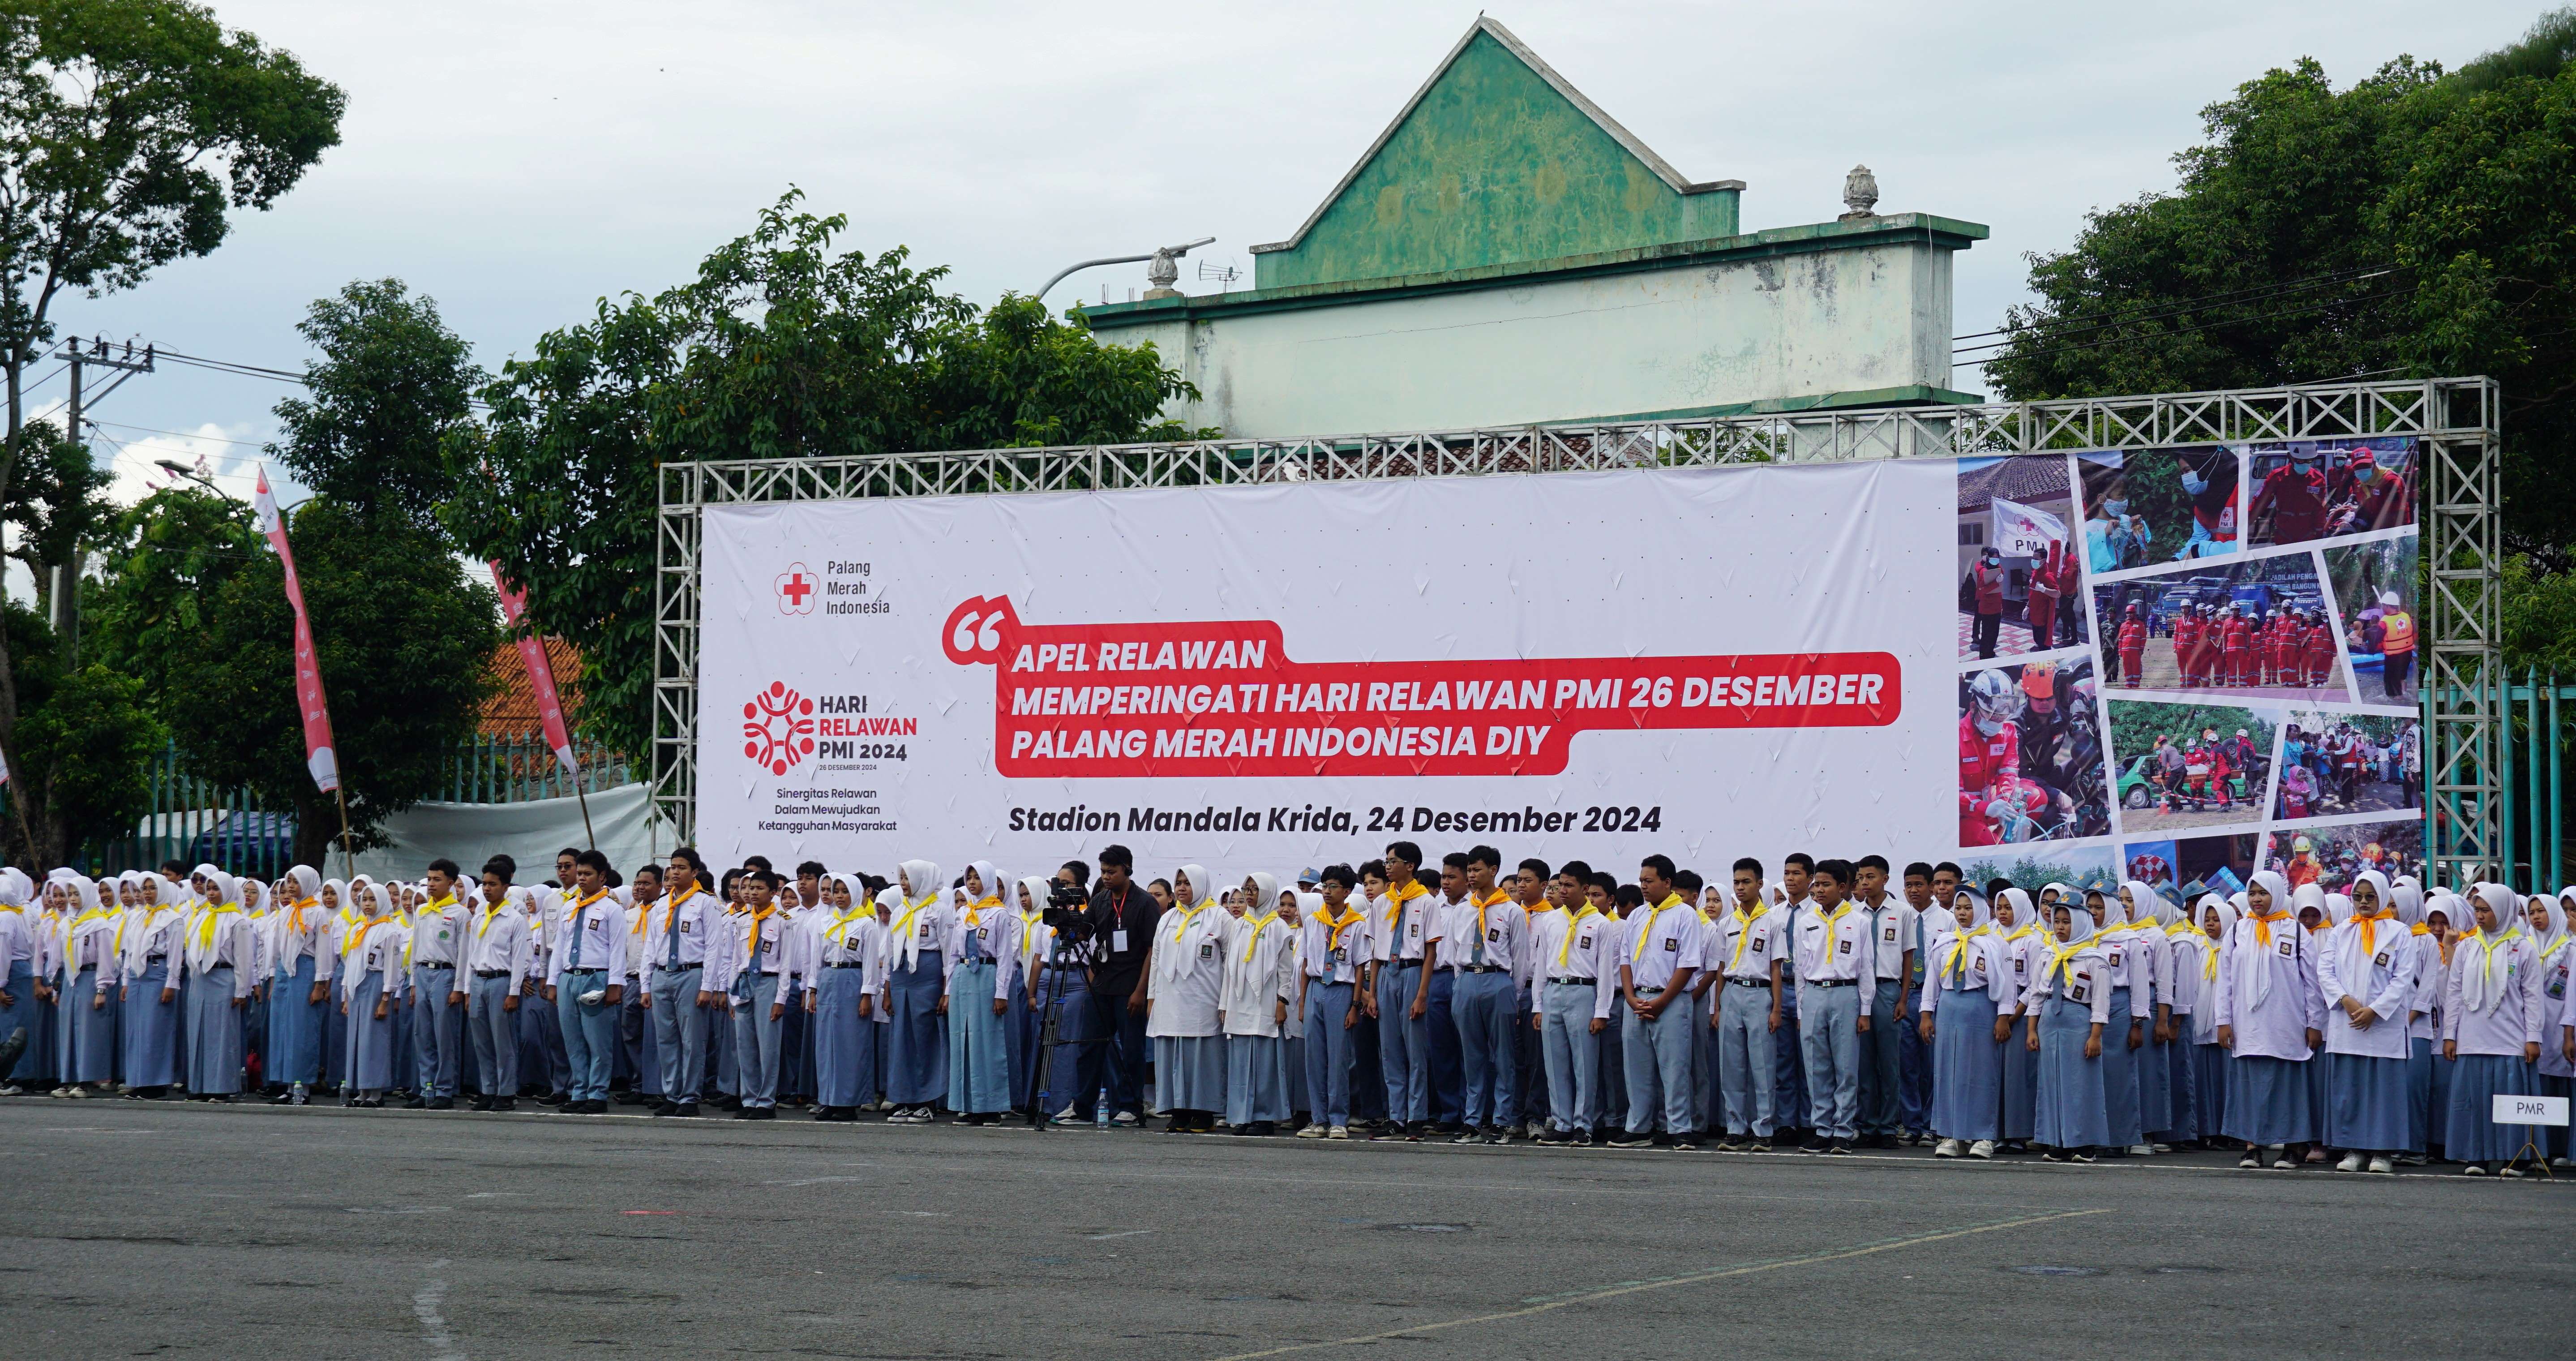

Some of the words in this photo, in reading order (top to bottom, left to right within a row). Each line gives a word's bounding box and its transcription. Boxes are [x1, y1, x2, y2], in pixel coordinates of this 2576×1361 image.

[828, 560, 870, 576] Palang
[827, 581, 866, 595] Merah
[827, 601, 890, 614] Indonesia
[1011, 644, 1089, 672] APEL
[1097, 640, 1266, 671] RELAWAN
[1011, 684, 1269, 715] MEMPERINGATI
[1275, 683, 1360, 712] HARI
[1366, 680, 1547, 711] RELAWAN
[1554, 678, 1623, 709] PMI
[1628, 676, 1673, 708] 26
[1681, 674, 1883, 707] DESEMBER
[820, 696, 867, 713] HARI
[819, 717, 917, 736] RELAWAN
[1011, 730, 1147, 759] PALANG
[1153, 728, 1276, 757] MERAH
[1282, 726, 1477, 756] INDONESIA
[1485, 726, 1551, 755] DIY
[819, 741, 853, 759] PMI
[860, 744, 907, 761] 2024
[777, 788, 829, 801] Sinergitas
[831, 788, 876, 799] Relawan
[775, 804, 810, 814] Dalam
[812, 804, 880, 817] Mewujudkan
[759, 821, 831, 833] Ketangguhan
[833, 821, 897, 833] Masyarakat
[1009, 805, 1120, 832] Stadion
[1127, 806, 1261, 832] Mandala
[1267, 804, 1359, 836] Krida,
[1367, 807, 1403, 832] 24
[1412, 807, 1577, 832] Desember
[1583, 807, 1661, 832] 2024
[2517, 1102, 2545, 1115] PMR
